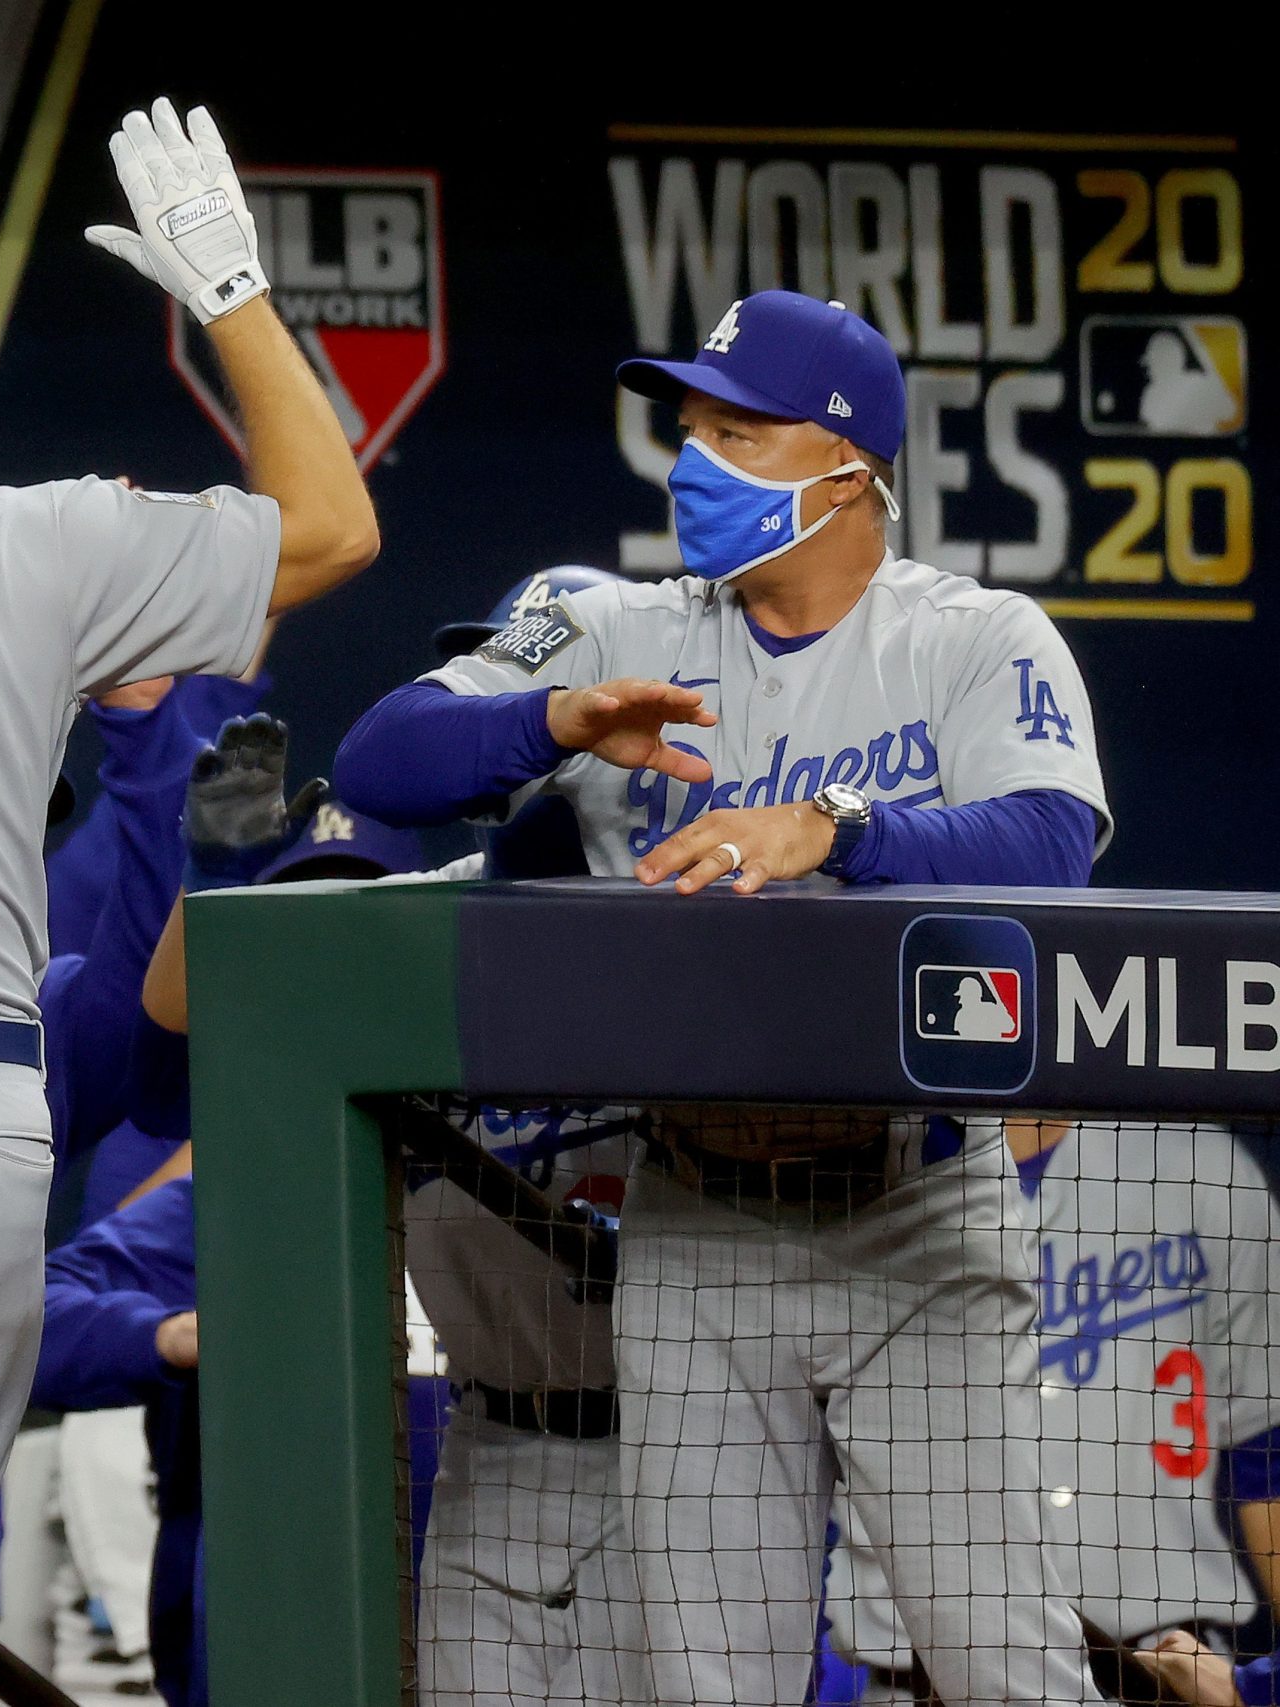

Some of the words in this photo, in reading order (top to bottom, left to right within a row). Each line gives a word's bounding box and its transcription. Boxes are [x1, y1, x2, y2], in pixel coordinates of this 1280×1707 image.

[166, 196, 227, 235] Franklin
[608, 156, 1066, 364] WORLD
[1076, 169, 1245, 295] 20
[275, 295, 426, 327] WORK
[703, 300, 744, 354] LA
[616, 368, 1069, 582] SES
[760, 514, 780, 532] 30
[1081, 457, 1253, 587] 20
[481, 630, 550, 664] SERIES
[1012, 658, 1076, 750] LA
[1056, 952, 1280, 1072] MLB
[1033, 1230, 1209, 1385] dgers
[1150, 1349, 1210, 1480] 3
